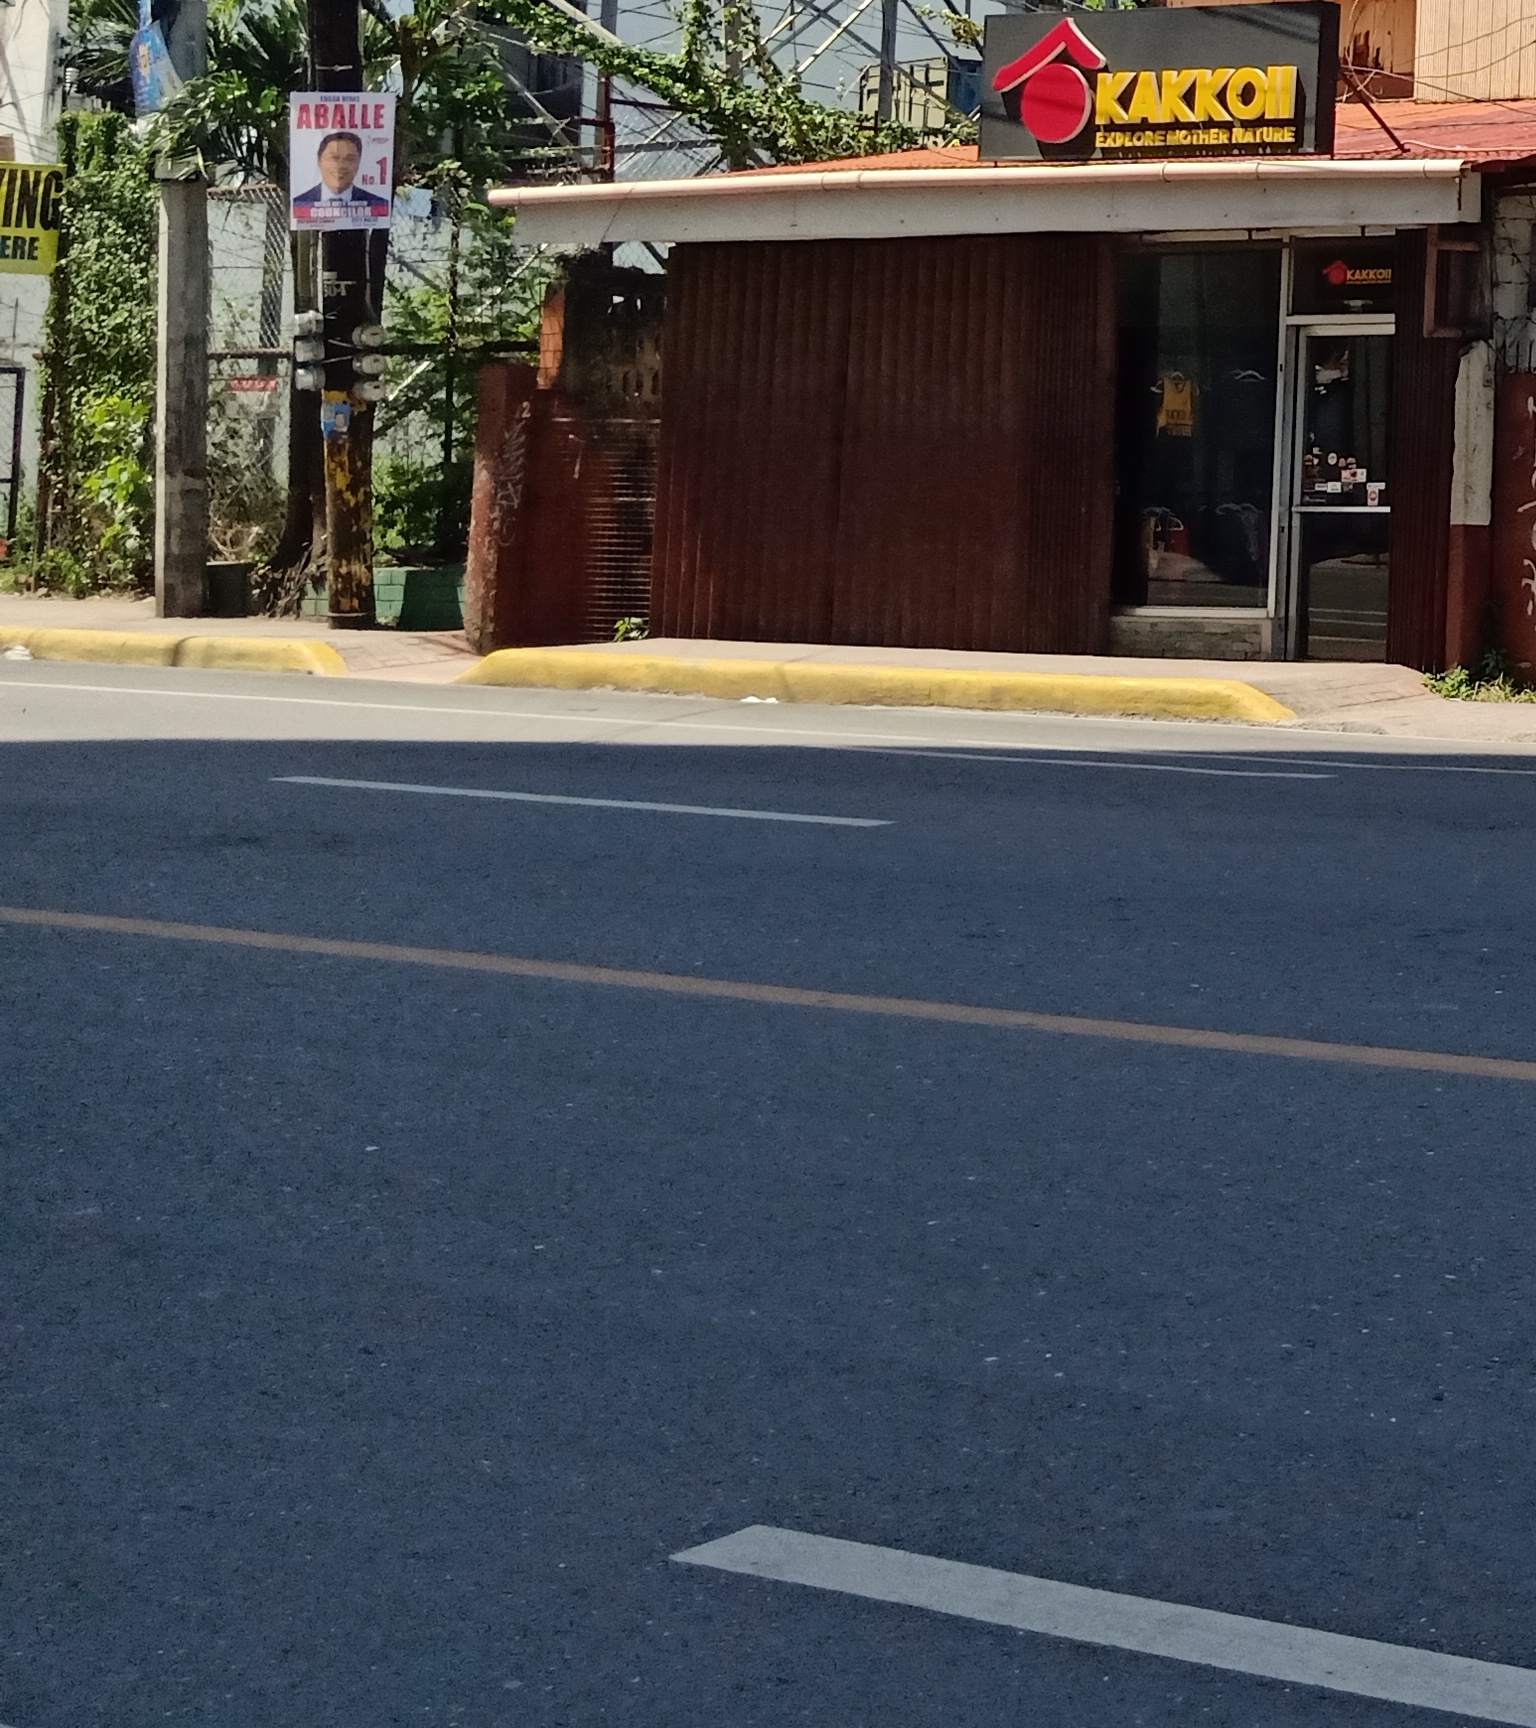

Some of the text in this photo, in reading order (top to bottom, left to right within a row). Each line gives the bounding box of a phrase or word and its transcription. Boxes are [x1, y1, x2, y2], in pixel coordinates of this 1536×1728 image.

[297, 104, 385, 129] ABALLE
[1095, 126, 1297, 148] EXPLORE MOTHER NATURE
